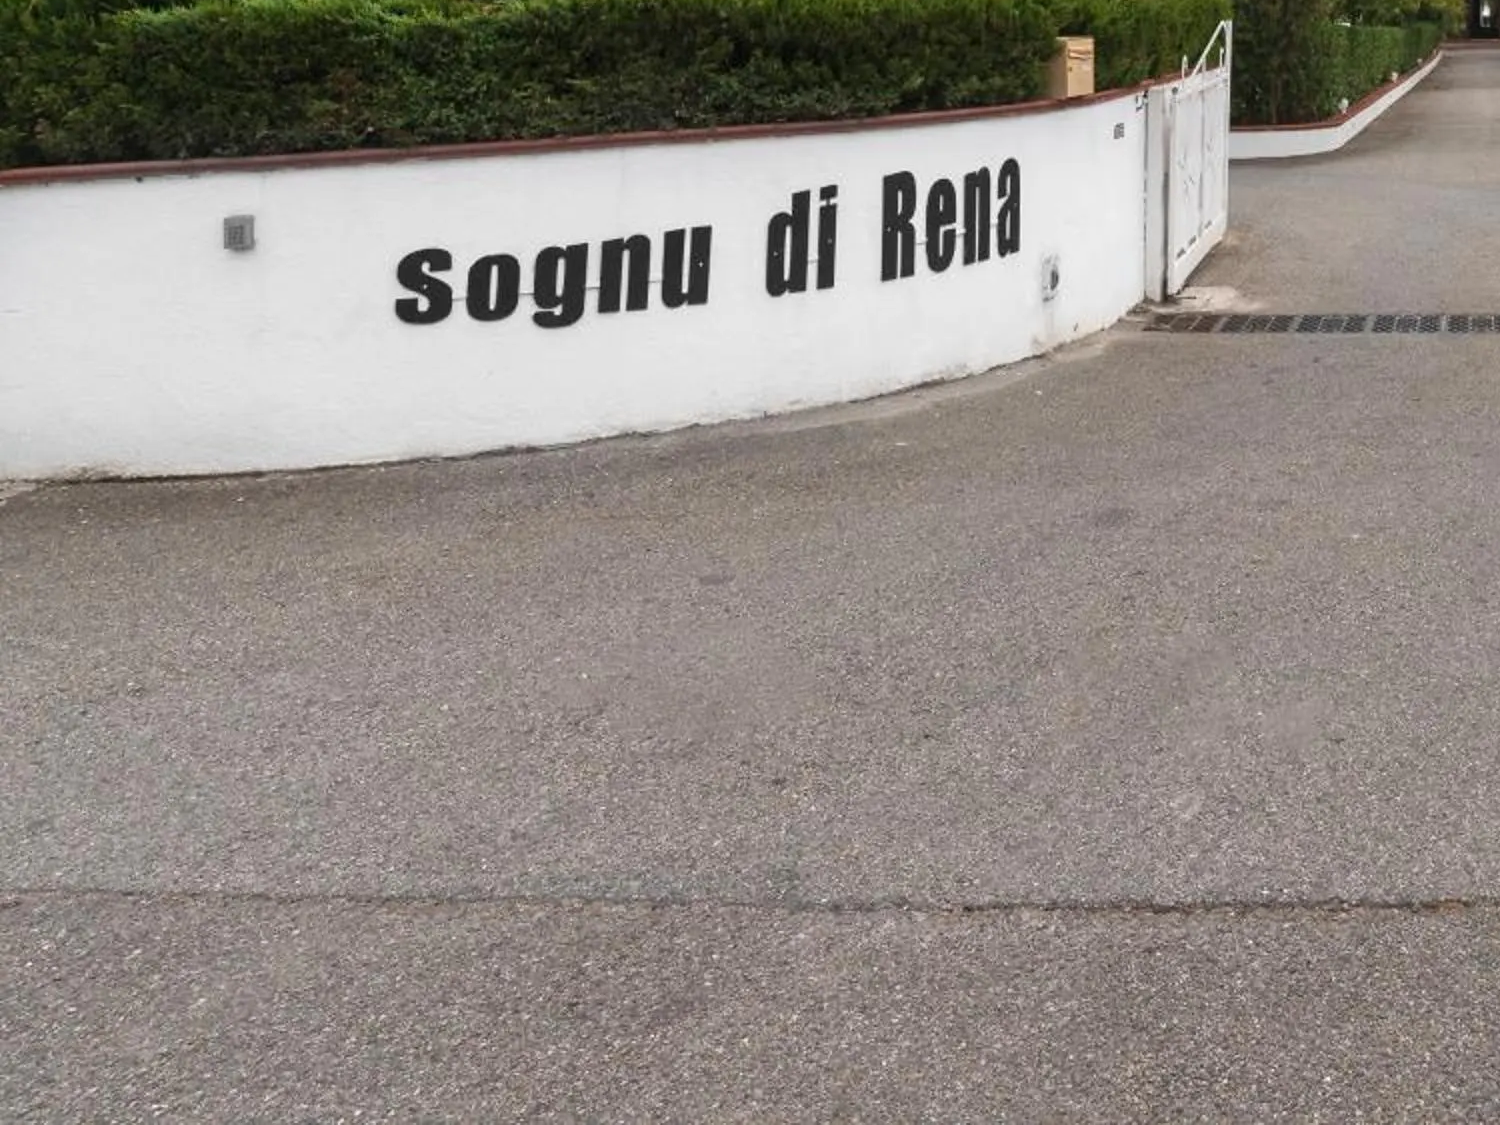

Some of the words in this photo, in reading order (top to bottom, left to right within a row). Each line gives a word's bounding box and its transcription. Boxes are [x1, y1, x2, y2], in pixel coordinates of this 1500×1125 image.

[395, 225, 713, 329] Sognu
[765, 184, 838, 297] di
[881, 157, 1021, 282] Rena
